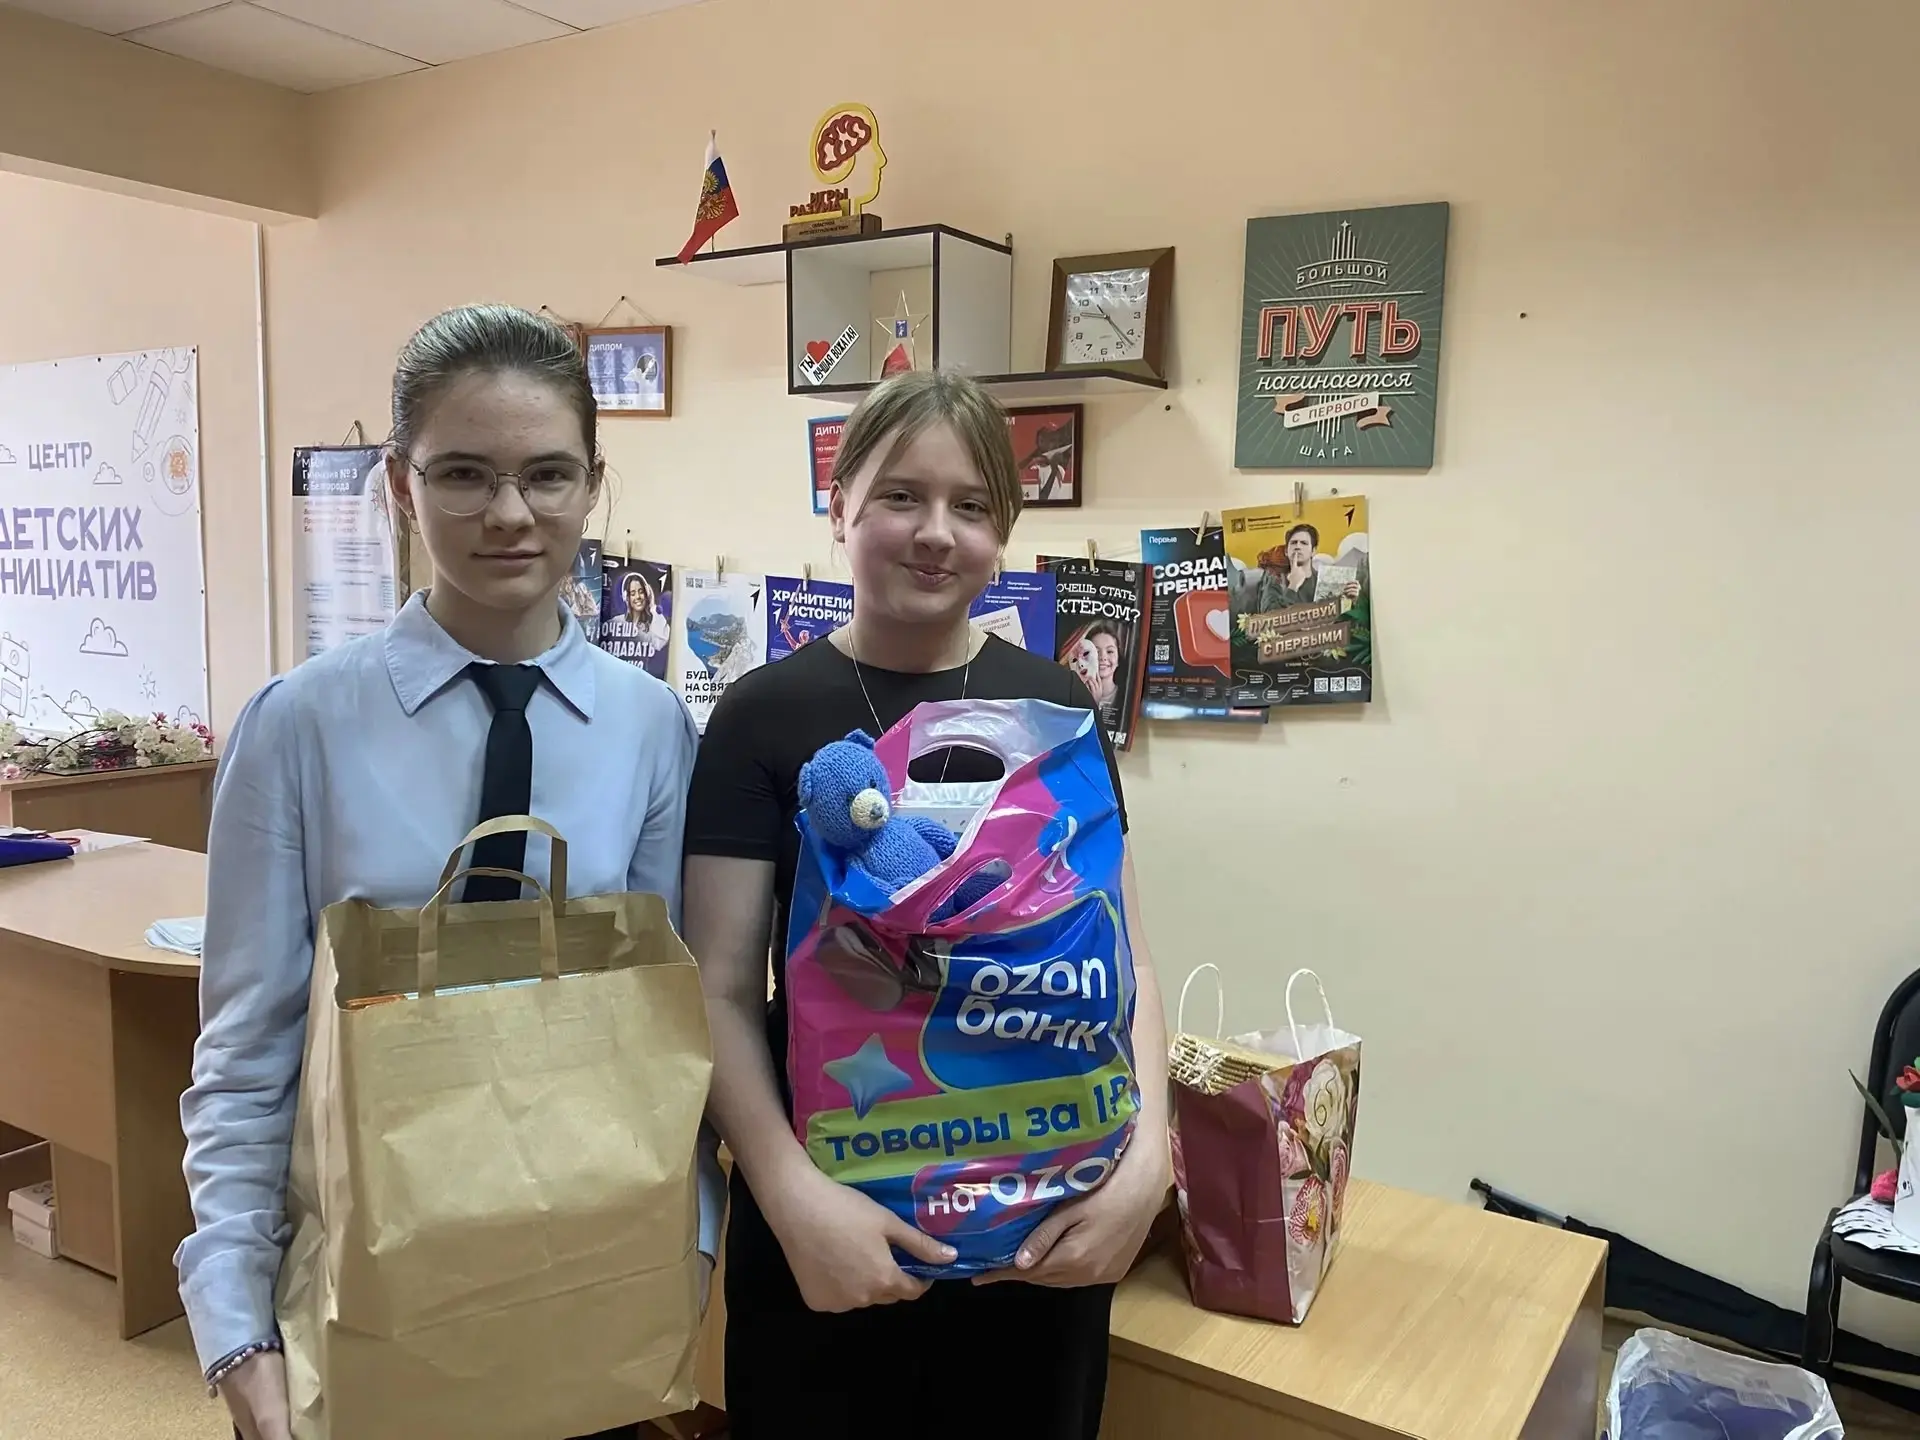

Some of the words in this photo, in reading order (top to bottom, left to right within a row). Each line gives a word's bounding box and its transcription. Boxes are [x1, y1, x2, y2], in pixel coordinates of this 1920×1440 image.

[810, 188, 848, 204] ИГРЫ
[790, 201, 842, 217] РАЗУМА
[1296, 264, 1388, 284] БОЛЬШОЙ
[1257, 301, 1421, 361] ПУТЬ
[589, 343, 623, 352] ДИПЛОМ
[812, 354, 835, 382] ЛУЧШАЯ
[831, 326, 858, 360] ВОЖАТАЯ
[1116, 341, 1123, 349] 5
[800, 355, 815, 373] ТЫ
[1256, 371, 1413, 391] начинается
[1292, 412, 1301, 424] С
[1308, 397, 1369, 420] ПЕРВОГО
[815, 425, 847, 437] ДИПЛ
[28, 441, 93, 472] ЦЕНТР
[1299, 445, 1353, 458] ШАГА
[340, 469, 351, 479] №
[352, 468, 358, 479] 3
[303, 483, 309, 491] г.
[1149, 535, 1177, 546] Первые
[0, 557, 157, 601] НИЦИАТИВ
[772, 589, 852, 610] ХРАНИТЕЛИ
[1056, 583, 1097, 594] ОЧЕШЬ
[1099, 586, 1136, 602] СТАТЬ
[788, 605, 852, 623] ИСТОРИИ
[1056, 596, 1141, 623] КТЁРОМ?
[1250, 602, 1338, 635] ПУТЕШЕСТВУЙ
[601, 622, 639, 638] ОЧЕШЬ
[601, 640, 655, 658] ОЗДАВАТЬ
[1263, 645, 1273, 656] С
[1276, 630, 1343, 652] ПЕРВЫМИ
[685, 683, 700, 691] НА
[702, 682, 728, 692] СВЯ
[685, 695, 692, 704] С
[971, 957, 1106, 1000] ozon
[956, 996, 1108, 1053] банк
[826, 1112, 1011, 1162] товары
[1025, 1102, 1080, 1138] за
[927, 1188, 976, 1216] на
